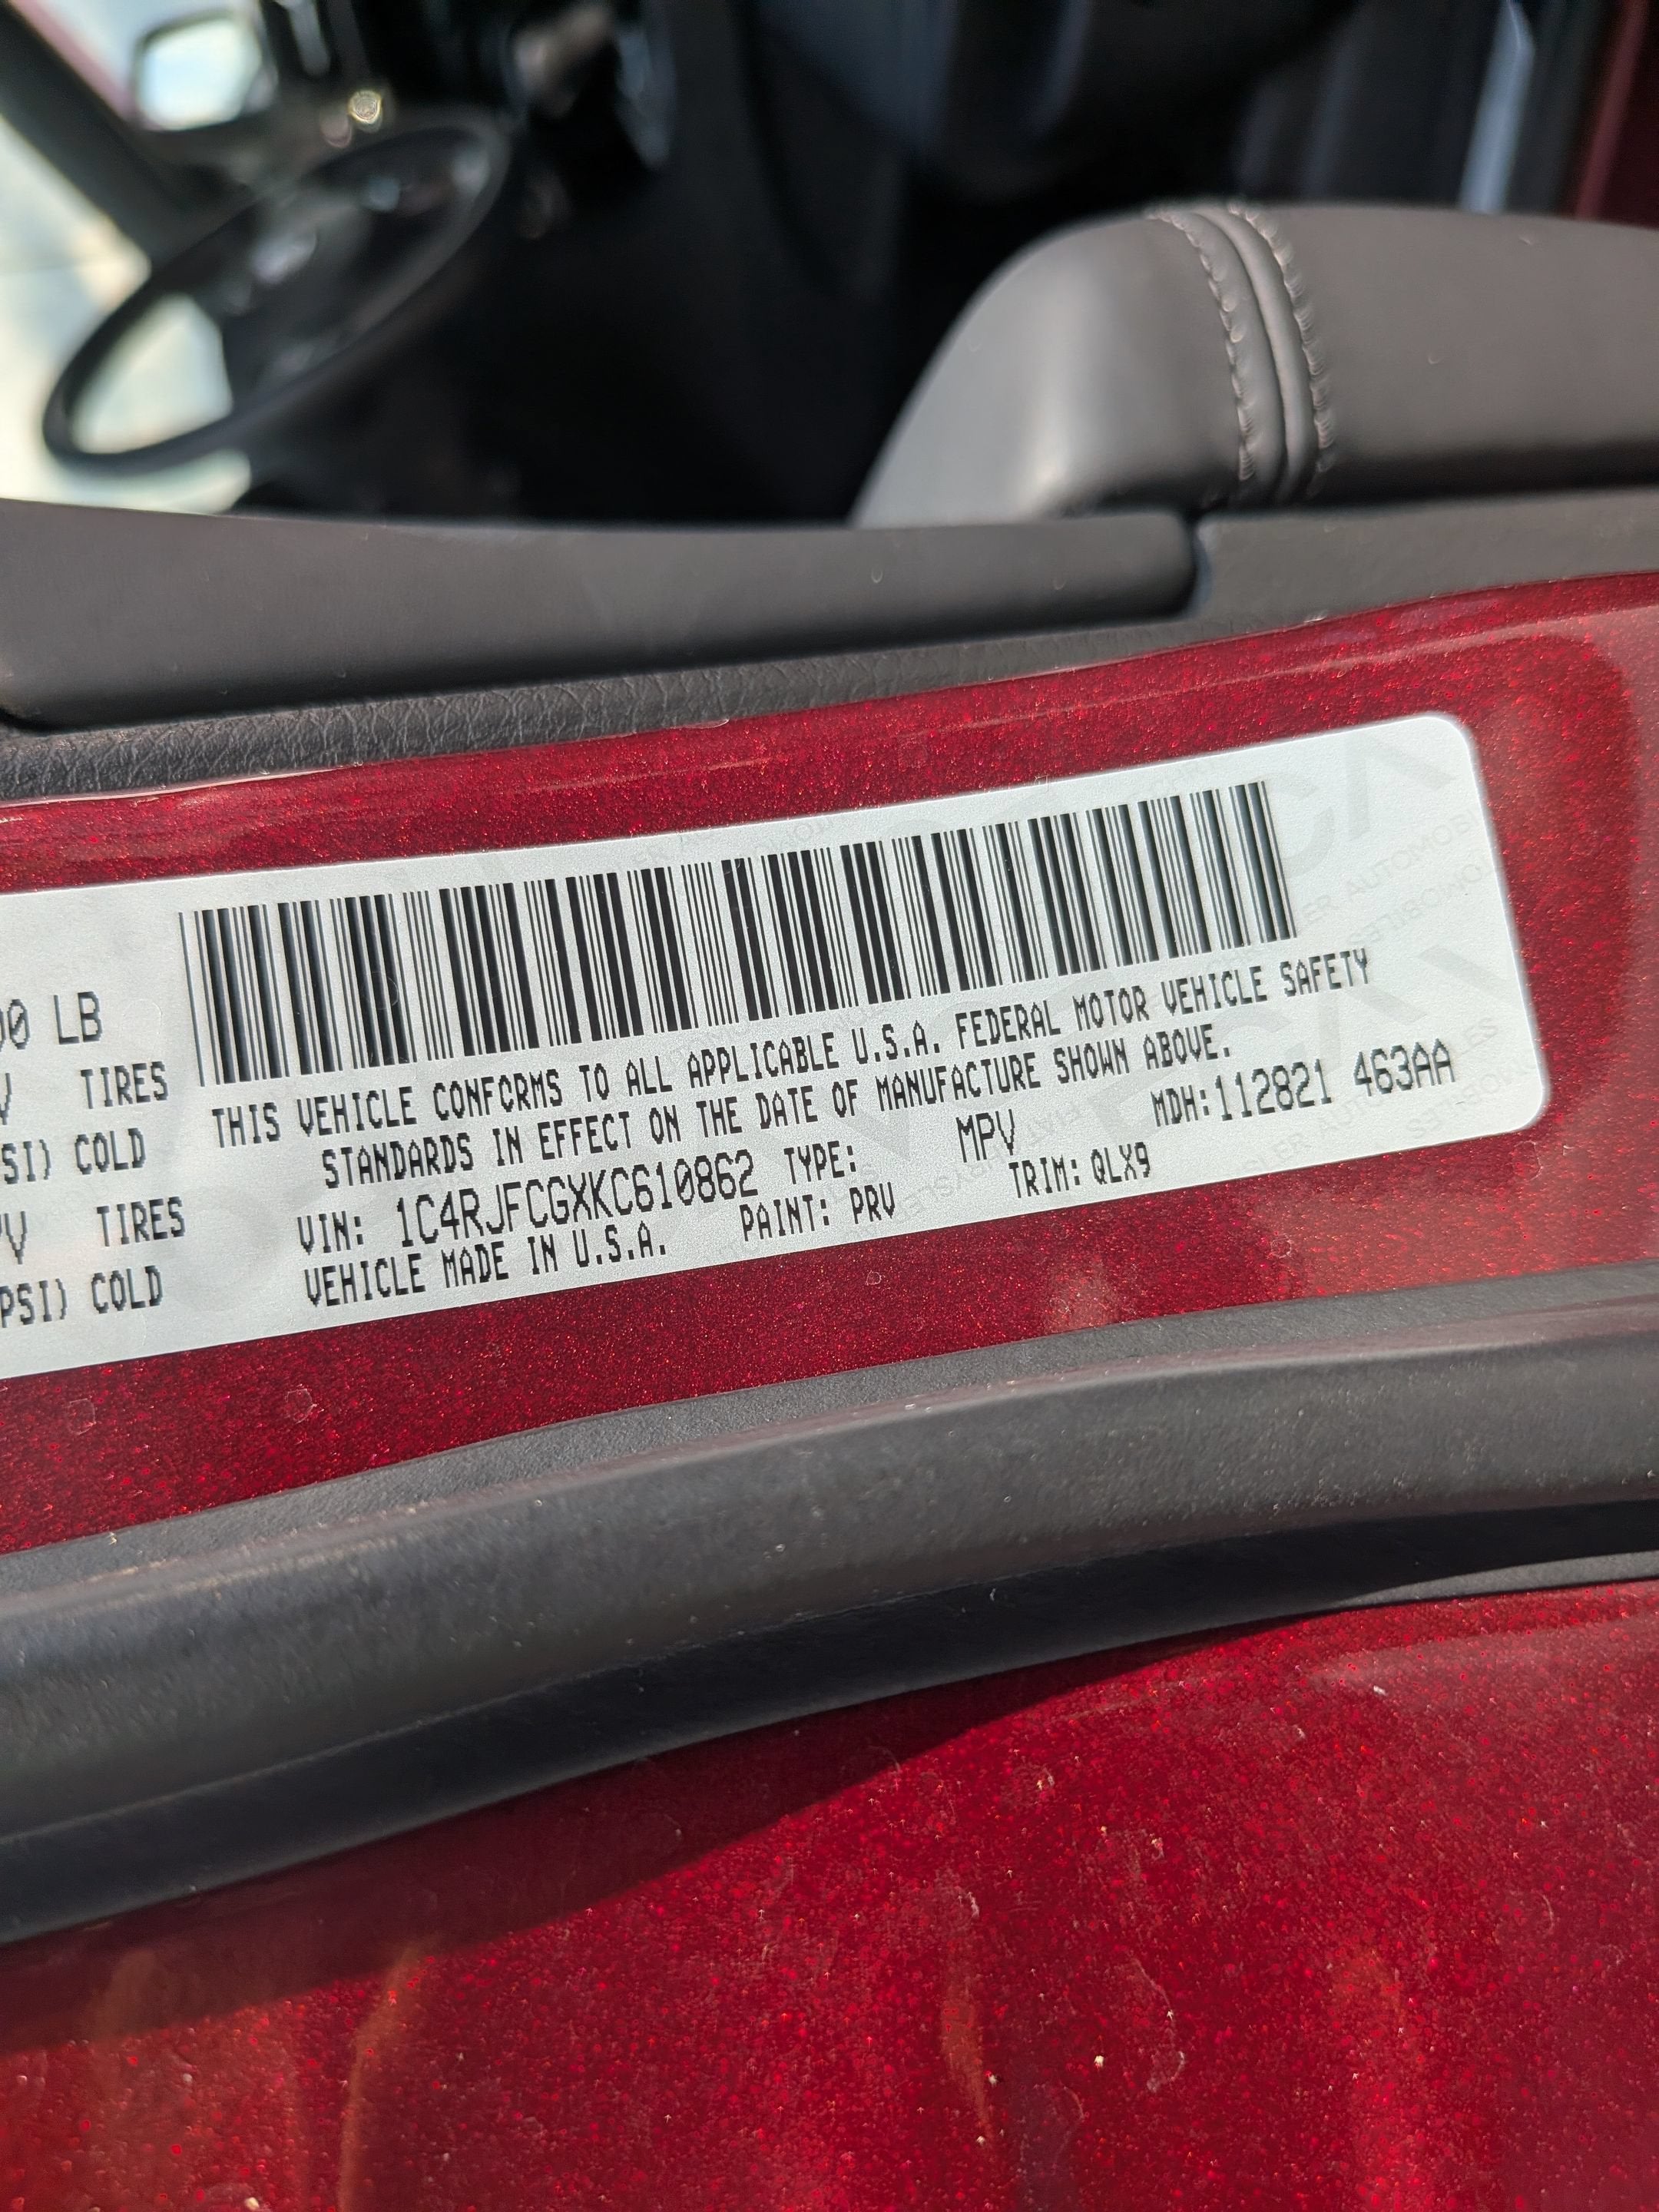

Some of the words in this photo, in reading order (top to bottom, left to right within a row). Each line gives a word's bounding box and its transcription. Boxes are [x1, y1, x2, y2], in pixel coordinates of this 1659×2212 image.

[54, 991, 103, 1045] LB
[212, 1102, 280, 1148] THIS
[297, 1086, 416, 1137] VEHICLE
[432, 1068, 562, 1121] CONFORMS
[579, 1063, 609, 1102] TO
[625, 1056, 672, 1097] ALL
[687, 1032, 839, 1088] APPLICABLE
[851, 1020, 939, 1064] U.S.A.
[955, 1000, 1061, 1049] FEDERAL
[1073, 985, 1149, 1031] MOTOR
[1161, 966, 1267, 1015] VEHICLE
[1280, 948, 1368, 997] SAFETY
[80, 1061, 168, 1109] TIRES
[322, 1133, 473, 1189] STANDARDS
[492, 1126, 523, 1166] IN
[538, 1111, 631, 1160] EFFECT
[649, 1104, 680, 1144] ON
[696, 1097, 742, 1137] THE
[755, 1085, 818, 1129] DATE
[832, 1079, 858, 1118] OF
[876, 1052, 1041, 1111] MANUFACTURE
[1053, 1038, 1129, 1084] SHOWN
[1143, 1024, 1230, 1070] ABOVE.
[75, 1128, 146, 1175] COLD
[297, 1211, 363, 1255] VIN:
[396, 1149, 758, 1247] 1C4RJFCGXKC610862
[783, 1141, 856, 1184] TYPE:
[955, 1109, 1015, 1163] MPV
[1353, 1038, 1455, 1096] 463AA
[0, 1210, 28, 1265] V
[96, 1196, 185, 1247] TIRES
[304, 1253, 426, 1306] VEHICLE
[442, 1241, 508, 1288] MADE
[528, 1234, 558, 1274] IN
[572, 1220, 666, 1267] U.S.A.
[740, 1194, 830, 1241] PAINT:
[849, 1182, 895, 1224] PRV
[1008, 1155, 1080, 1198] TRIM:
[1091, 1142, 1151, 1184] QLX9
[91, 1266, 163, 1314] COLD
